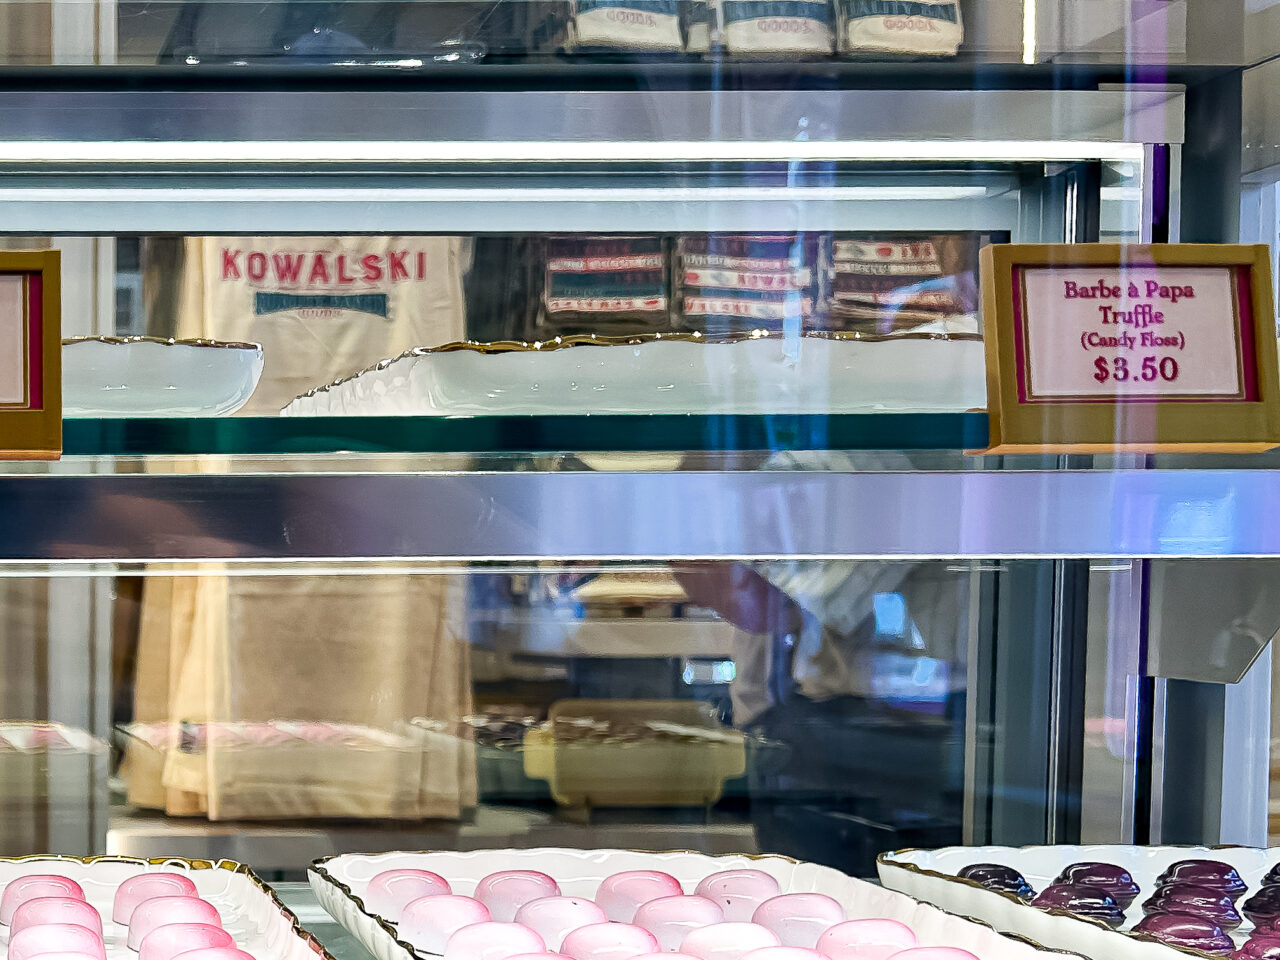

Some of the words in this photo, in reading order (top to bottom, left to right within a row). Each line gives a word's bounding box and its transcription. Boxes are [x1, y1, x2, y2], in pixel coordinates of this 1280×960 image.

[220, 248, 428, 285] KOWALSKI
[1064, 279, 1122, 299] Barbe
[1128, 282, 1140, 298] à
[1145, 280, 1195, 303] Papa
[1098, 304, 1165, 328] Truffle
[1080, 331, 1136, 350] (Candy
[1140, 331, 1185, 350] Floss)
[1094, 355, 1179, 384] $3.50
